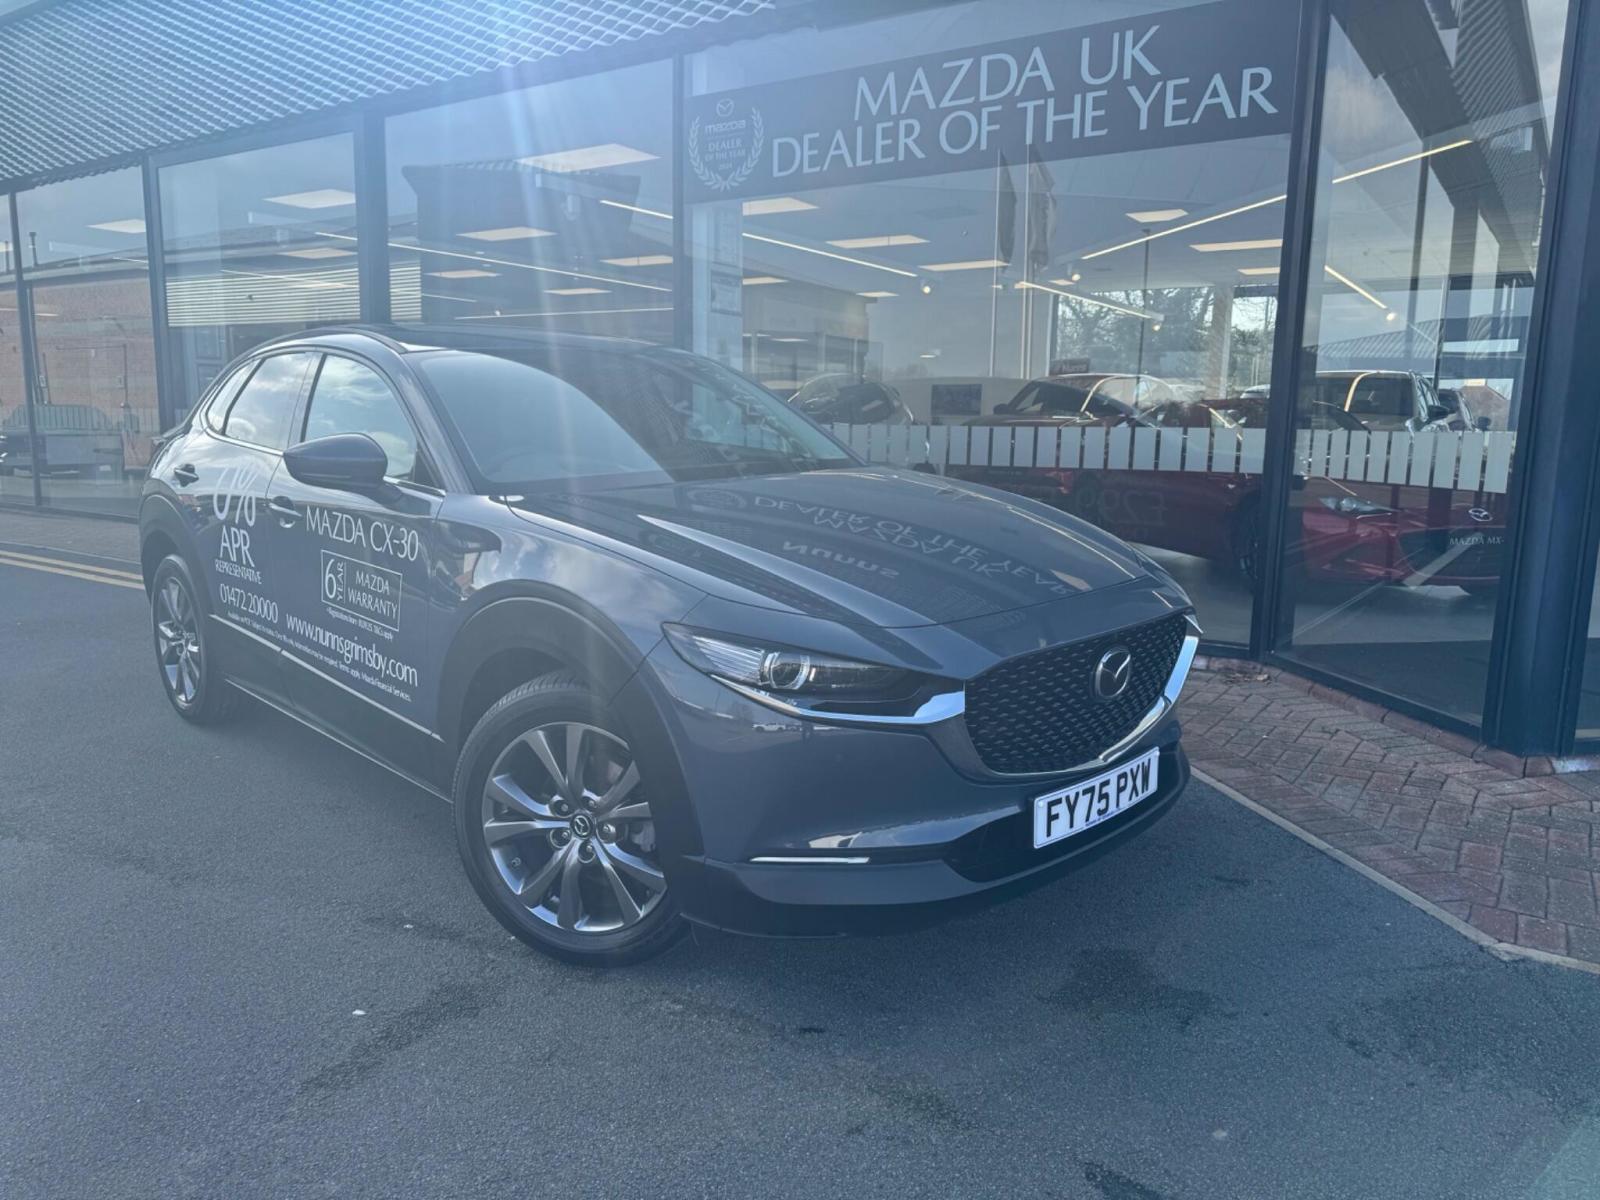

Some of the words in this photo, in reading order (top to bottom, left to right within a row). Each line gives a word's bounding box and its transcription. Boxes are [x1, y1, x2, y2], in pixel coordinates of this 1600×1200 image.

[854, 46, 1055, 121] MAZDA
[1079, 25, 1160, 87] UK
[704, 119, 746, 135] mazda
[772, 119, 926, 178] DEALER
[938, 106, 1002, 155] OF
[1018, 91, 1108, 145] THE
[1127, 66, 1278, 130] YEAR
[708, 138, 743, 151] DEALER
[213, 463, 260, 527] 0%
[220, 525, 255, 567] APR
[306, 506, 366, 548] MAZDA
[370, 521, 419, 561] CX-30
[1449, 535, 1485, 545] MAZDA
[220, 583, 247, 610] 01472
[325, 559, 337, 599] 6
[355, 570, 390, 595] MAZDA
[348, 587, 397, 619] WARRANTY
[286, 613, 418, 687] www.nunnsgrimsby.com
[1046, 779, 1111, 838] FY75
[1115, 758, 1152, 809] PXW
